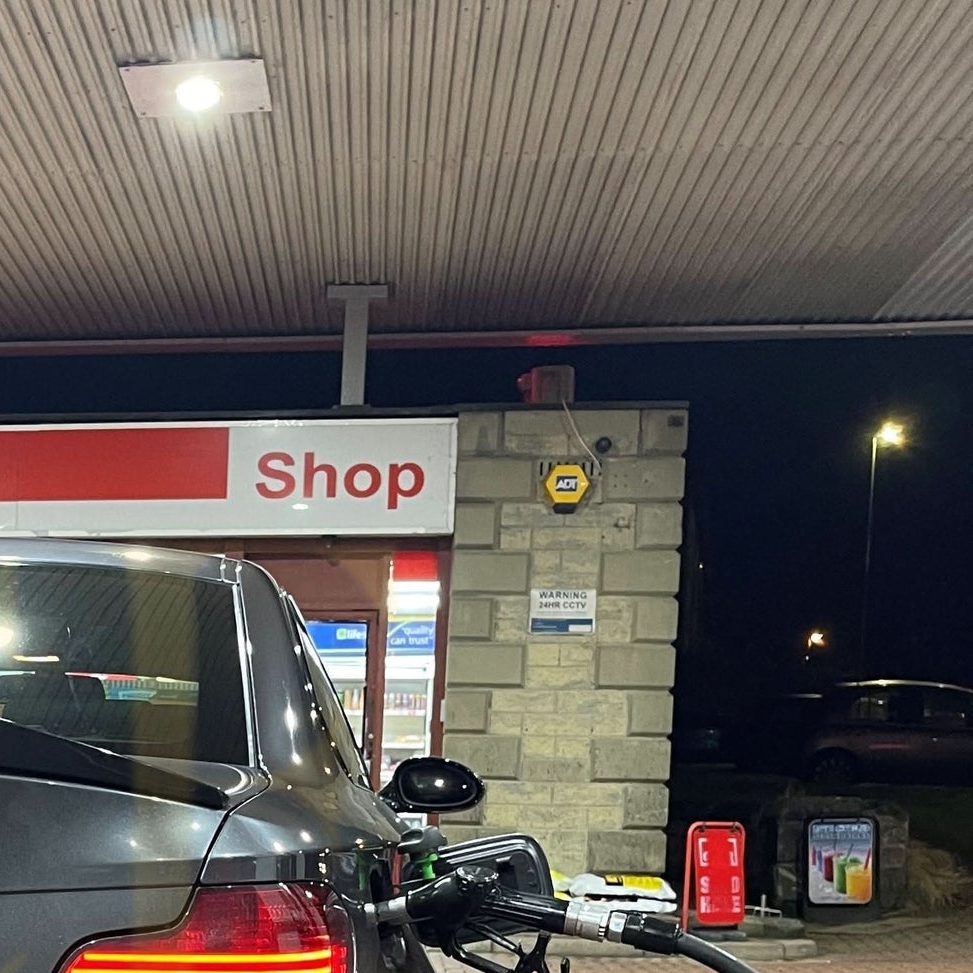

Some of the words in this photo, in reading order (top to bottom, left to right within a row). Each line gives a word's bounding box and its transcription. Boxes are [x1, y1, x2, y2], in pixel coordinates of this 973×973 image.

[255, 451, 425, 510] Shop
[555, 479, 578, 490] ADT
[539, 591, 587, 599] WARNING
[539, 601, 560, 609] 24HR
[563, 601, 587, 609] CCTV
